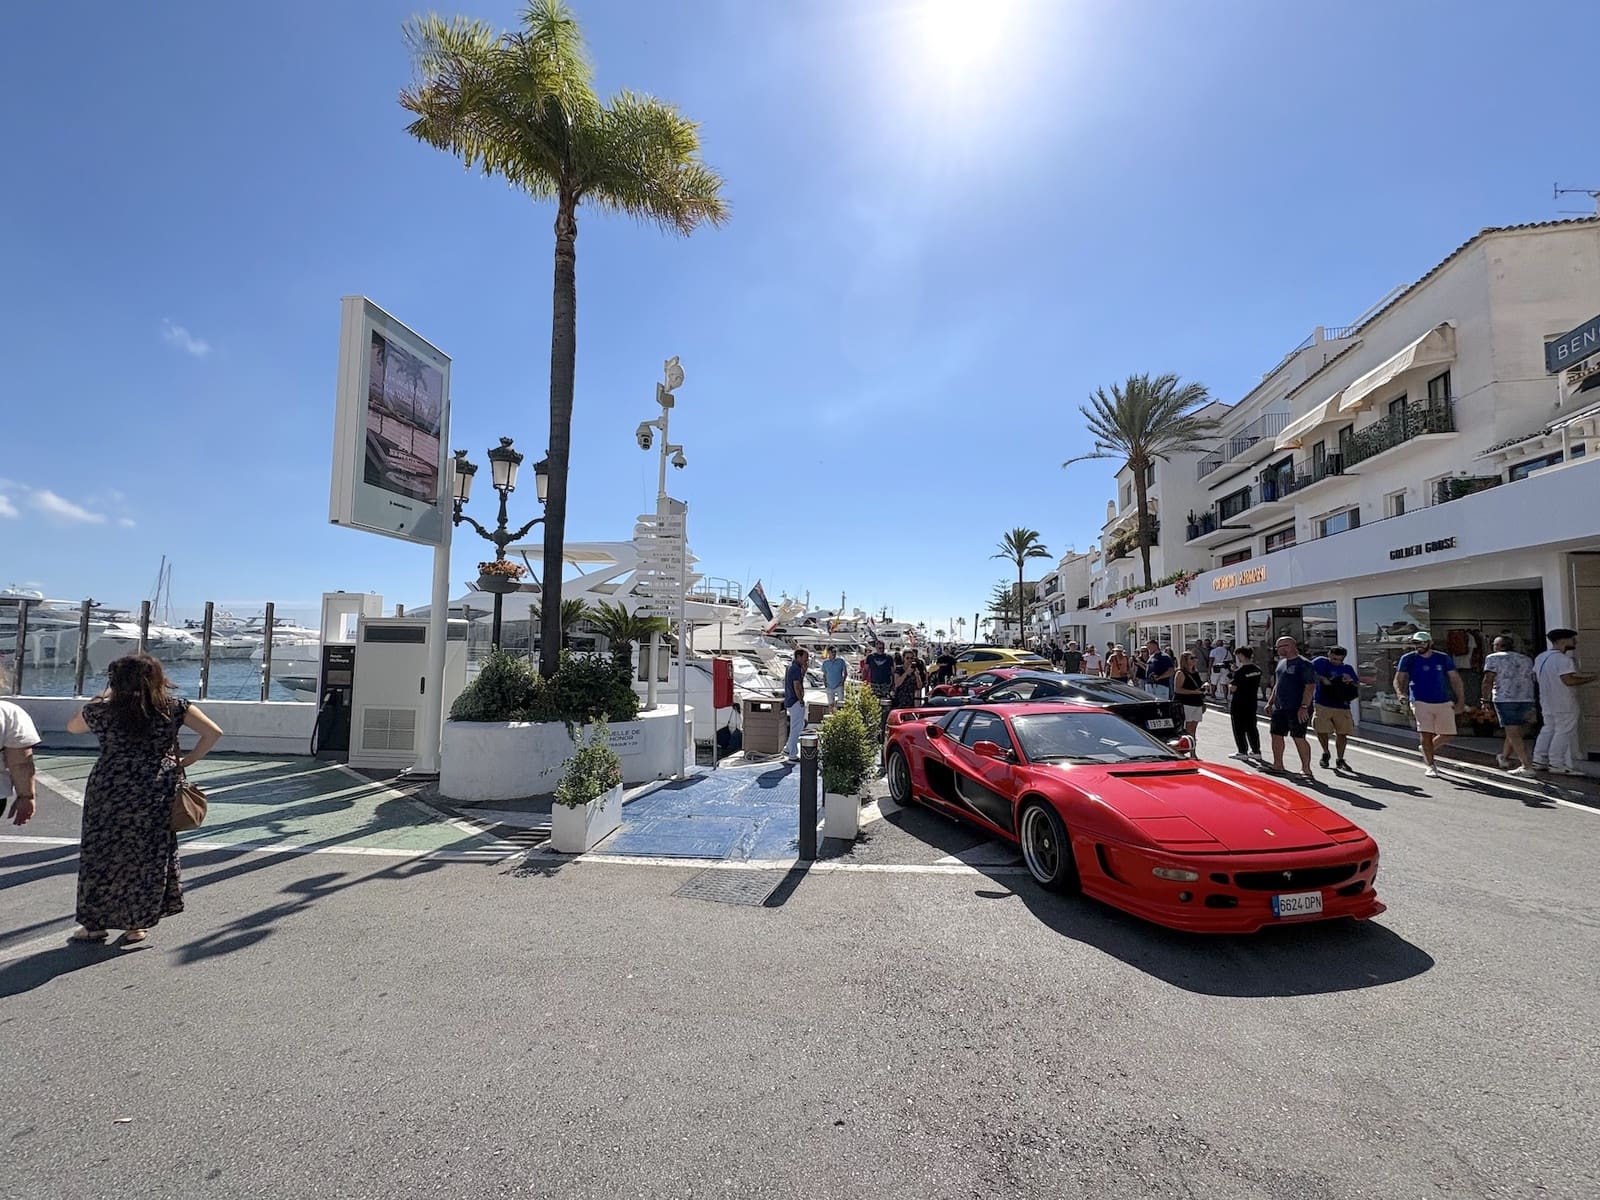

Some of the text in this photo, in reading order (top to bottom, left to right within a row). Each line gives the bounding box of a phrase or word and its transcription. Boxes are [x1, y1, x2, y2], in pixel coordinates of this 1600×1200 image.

[1558, 327, 1600, 361] BEN
[1389, 536, 1457, 560] GOLDEN GOOSE
[1280, 898, 1303, 912] 6624
